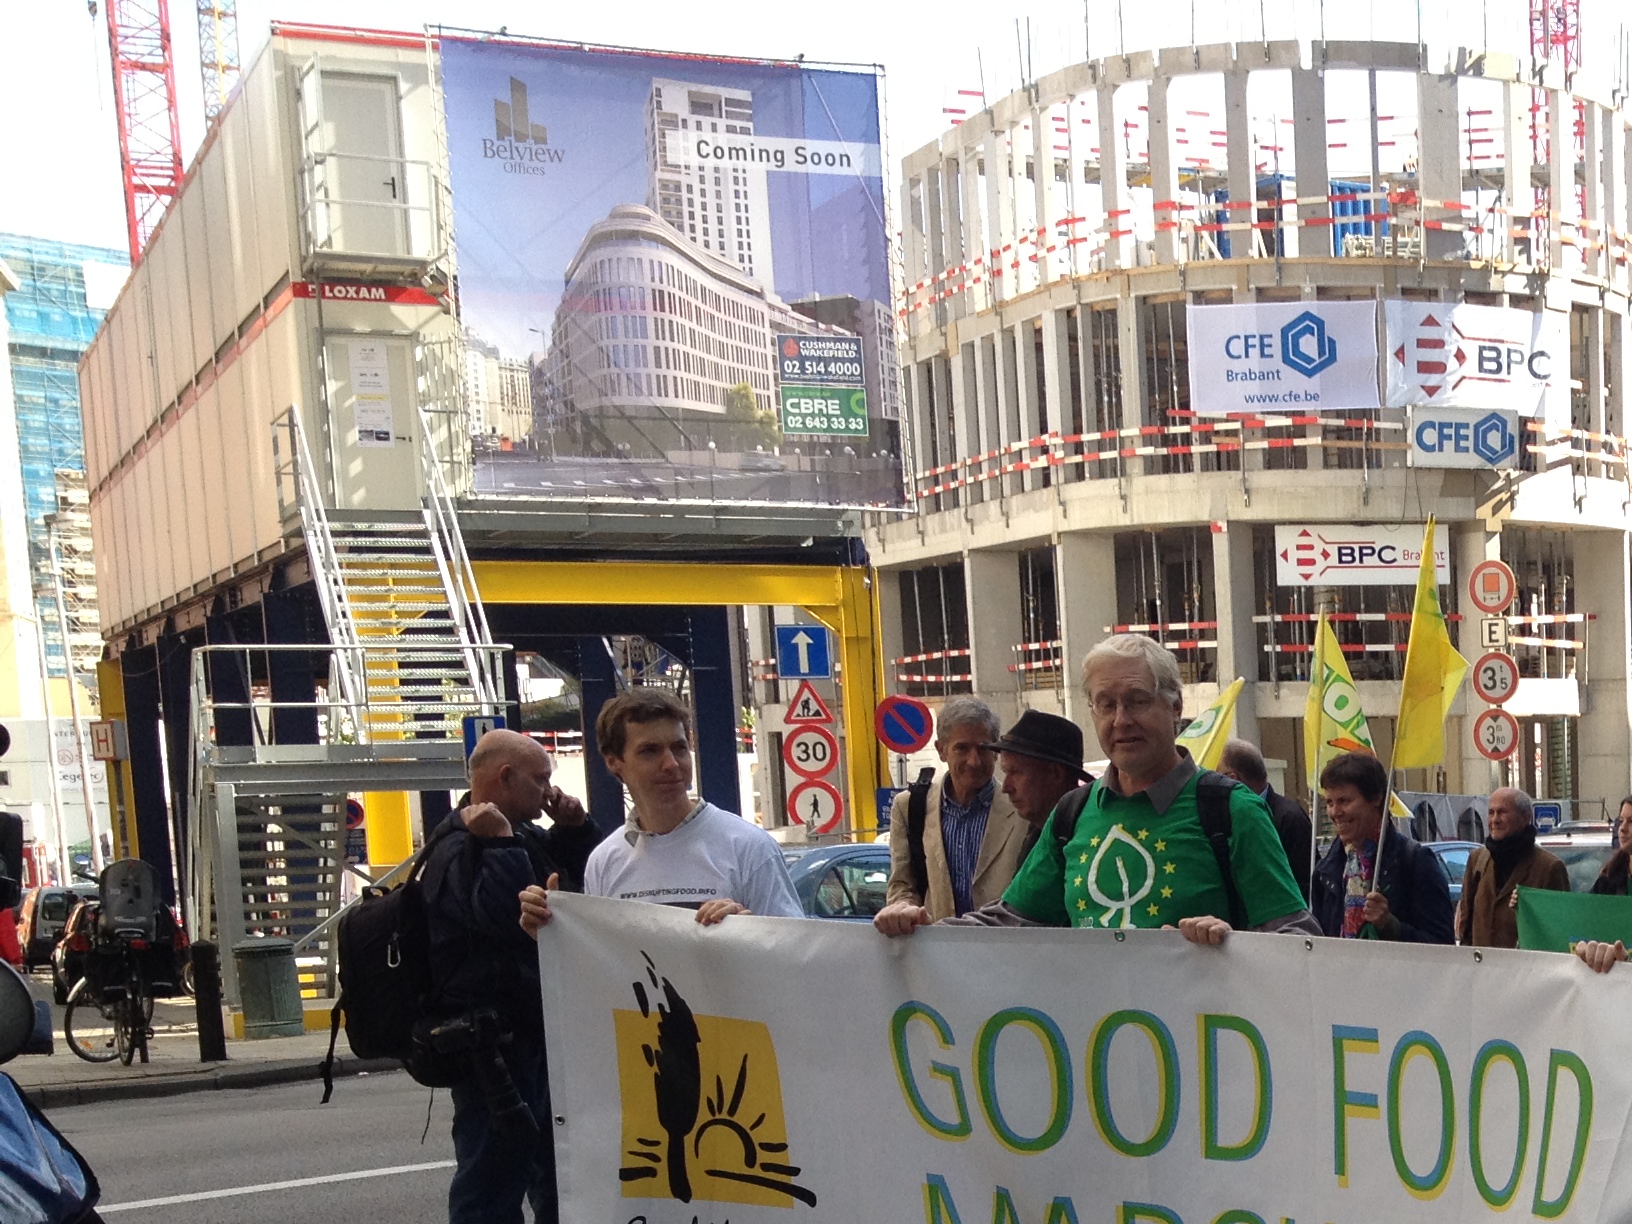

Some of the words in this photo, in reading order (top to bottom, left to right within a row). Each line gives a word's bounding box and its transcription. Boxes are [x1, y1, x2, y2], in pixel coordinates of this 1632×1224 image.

[482, 138, 565, 164] Belview
[696, 139, 786, 169] Coming
[794, 146, 852, 168] Soon
[503, 161, 546, 176] Offices
[324, 285, 386, 300] LOXAM
[799, 340, 850, 350] CUSHMAN
[800, 348, 856, 358] WAKEFIELD
[1225, 333, 1274, 360] CFE
[784, 360, 801, 374] 02
[804, 361, 825, 374] 514
[828, 361, 861, 376] 4000
[1478, 344, 1552, 381] BPC
[1226, 368, 1281, 382] Brabant
[785, 397, 841, 415] CBRE
[1244, 389, 1320, 404] www.cfe.be
[787, 415, 803, 428] 02
[805, 416, 828, 429] 643
[830, 417, 846, 430] 33
[848, 417, 864, 430] 33
[1415, 420, 1470, 453] CFE
[1337, 545, 1398, 565] BPC
[1402, 549, 1446, 562] Brant
[1488, 622, 1500, 643] E
[96, 728, 110, 753] H
[795, 741, 827, 763] 30
[888, 1000, 1274, 1163] GOOD
[1331, 1023, 1594, 1221] FOOD
